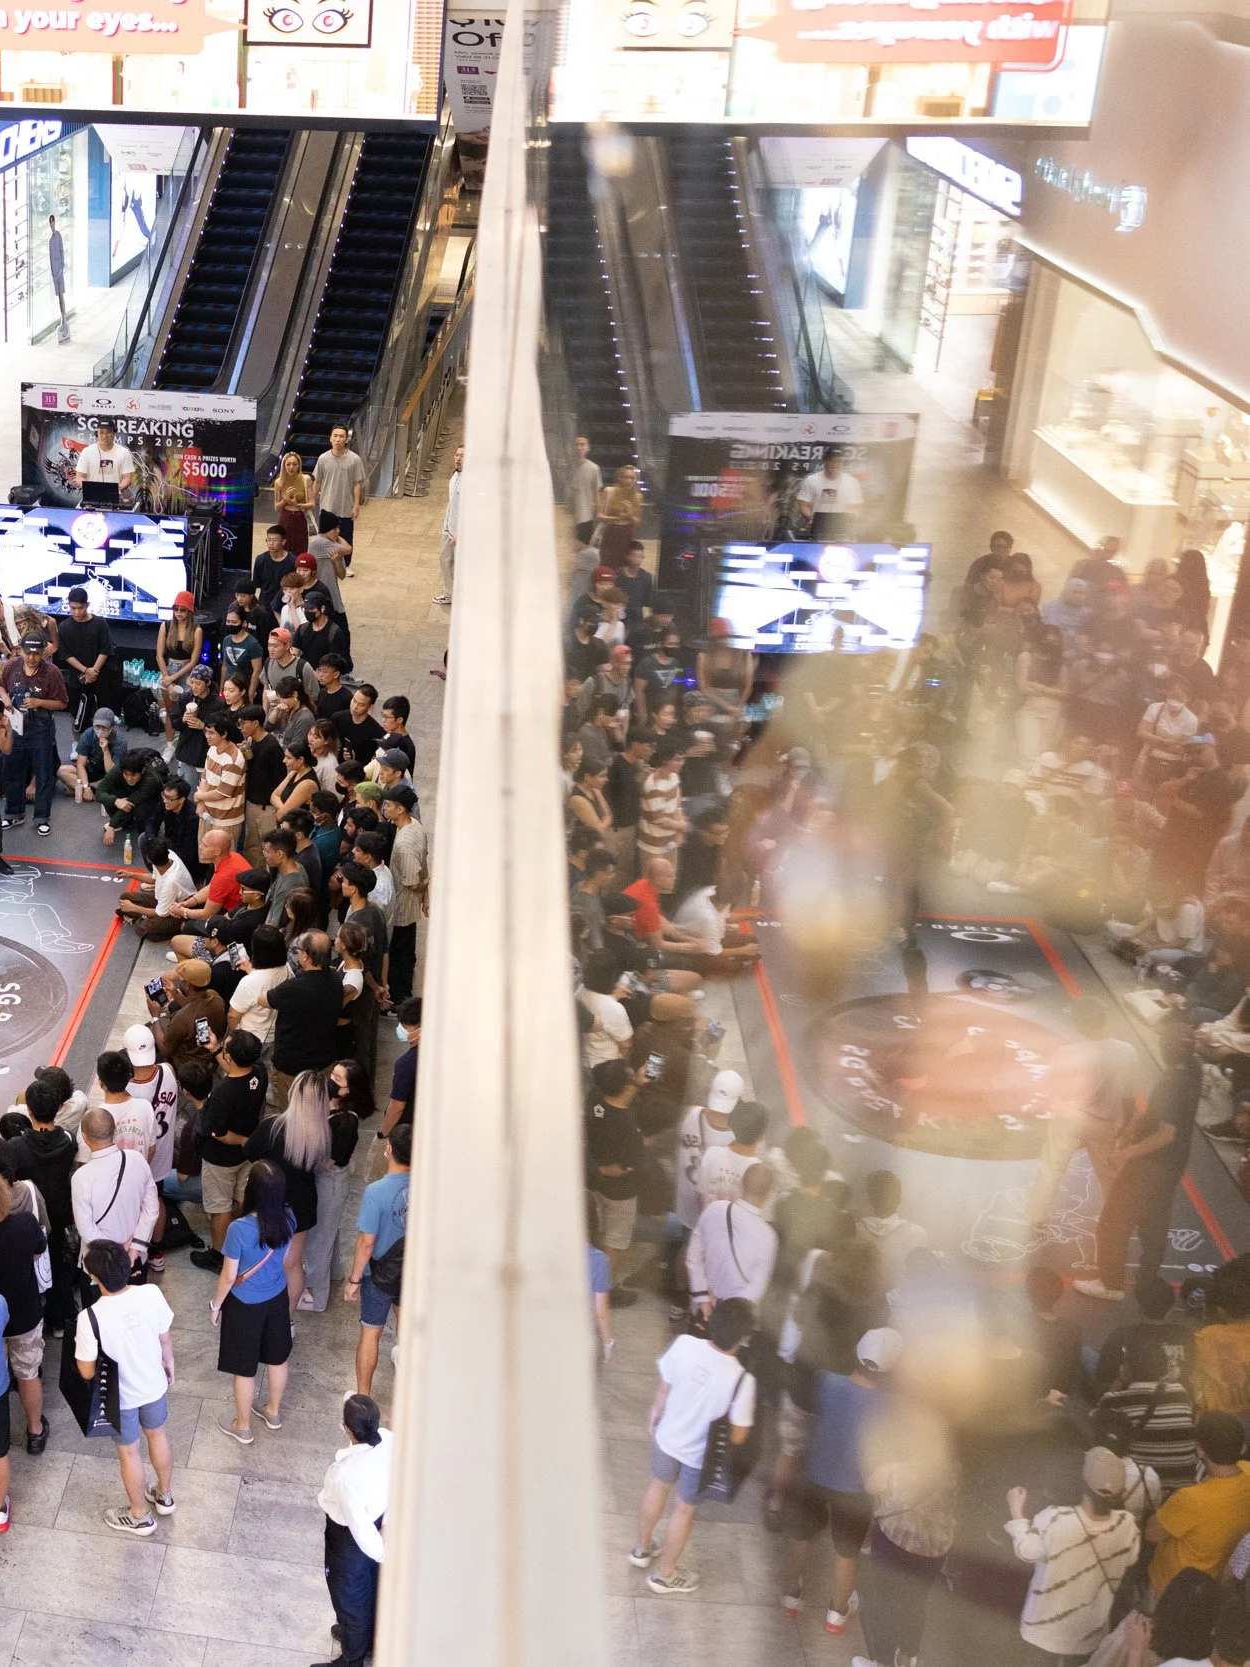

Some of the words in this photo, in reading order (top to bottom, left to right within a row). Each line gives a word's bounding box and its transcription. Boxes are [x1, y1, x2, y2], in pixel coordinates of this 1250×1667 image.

[14, 8, 80, 35] your
[86, 11, 178, 37] eyes...
[77, 417, 98, 431] SG
[114, 419, 194, 438] REAKING
[78, 433, 144, 445] CHMPS
[155, 438, 194, 448] 2022
[182, 460, 227, 478] $5000
[156, 1111, 169, 1139] 3
